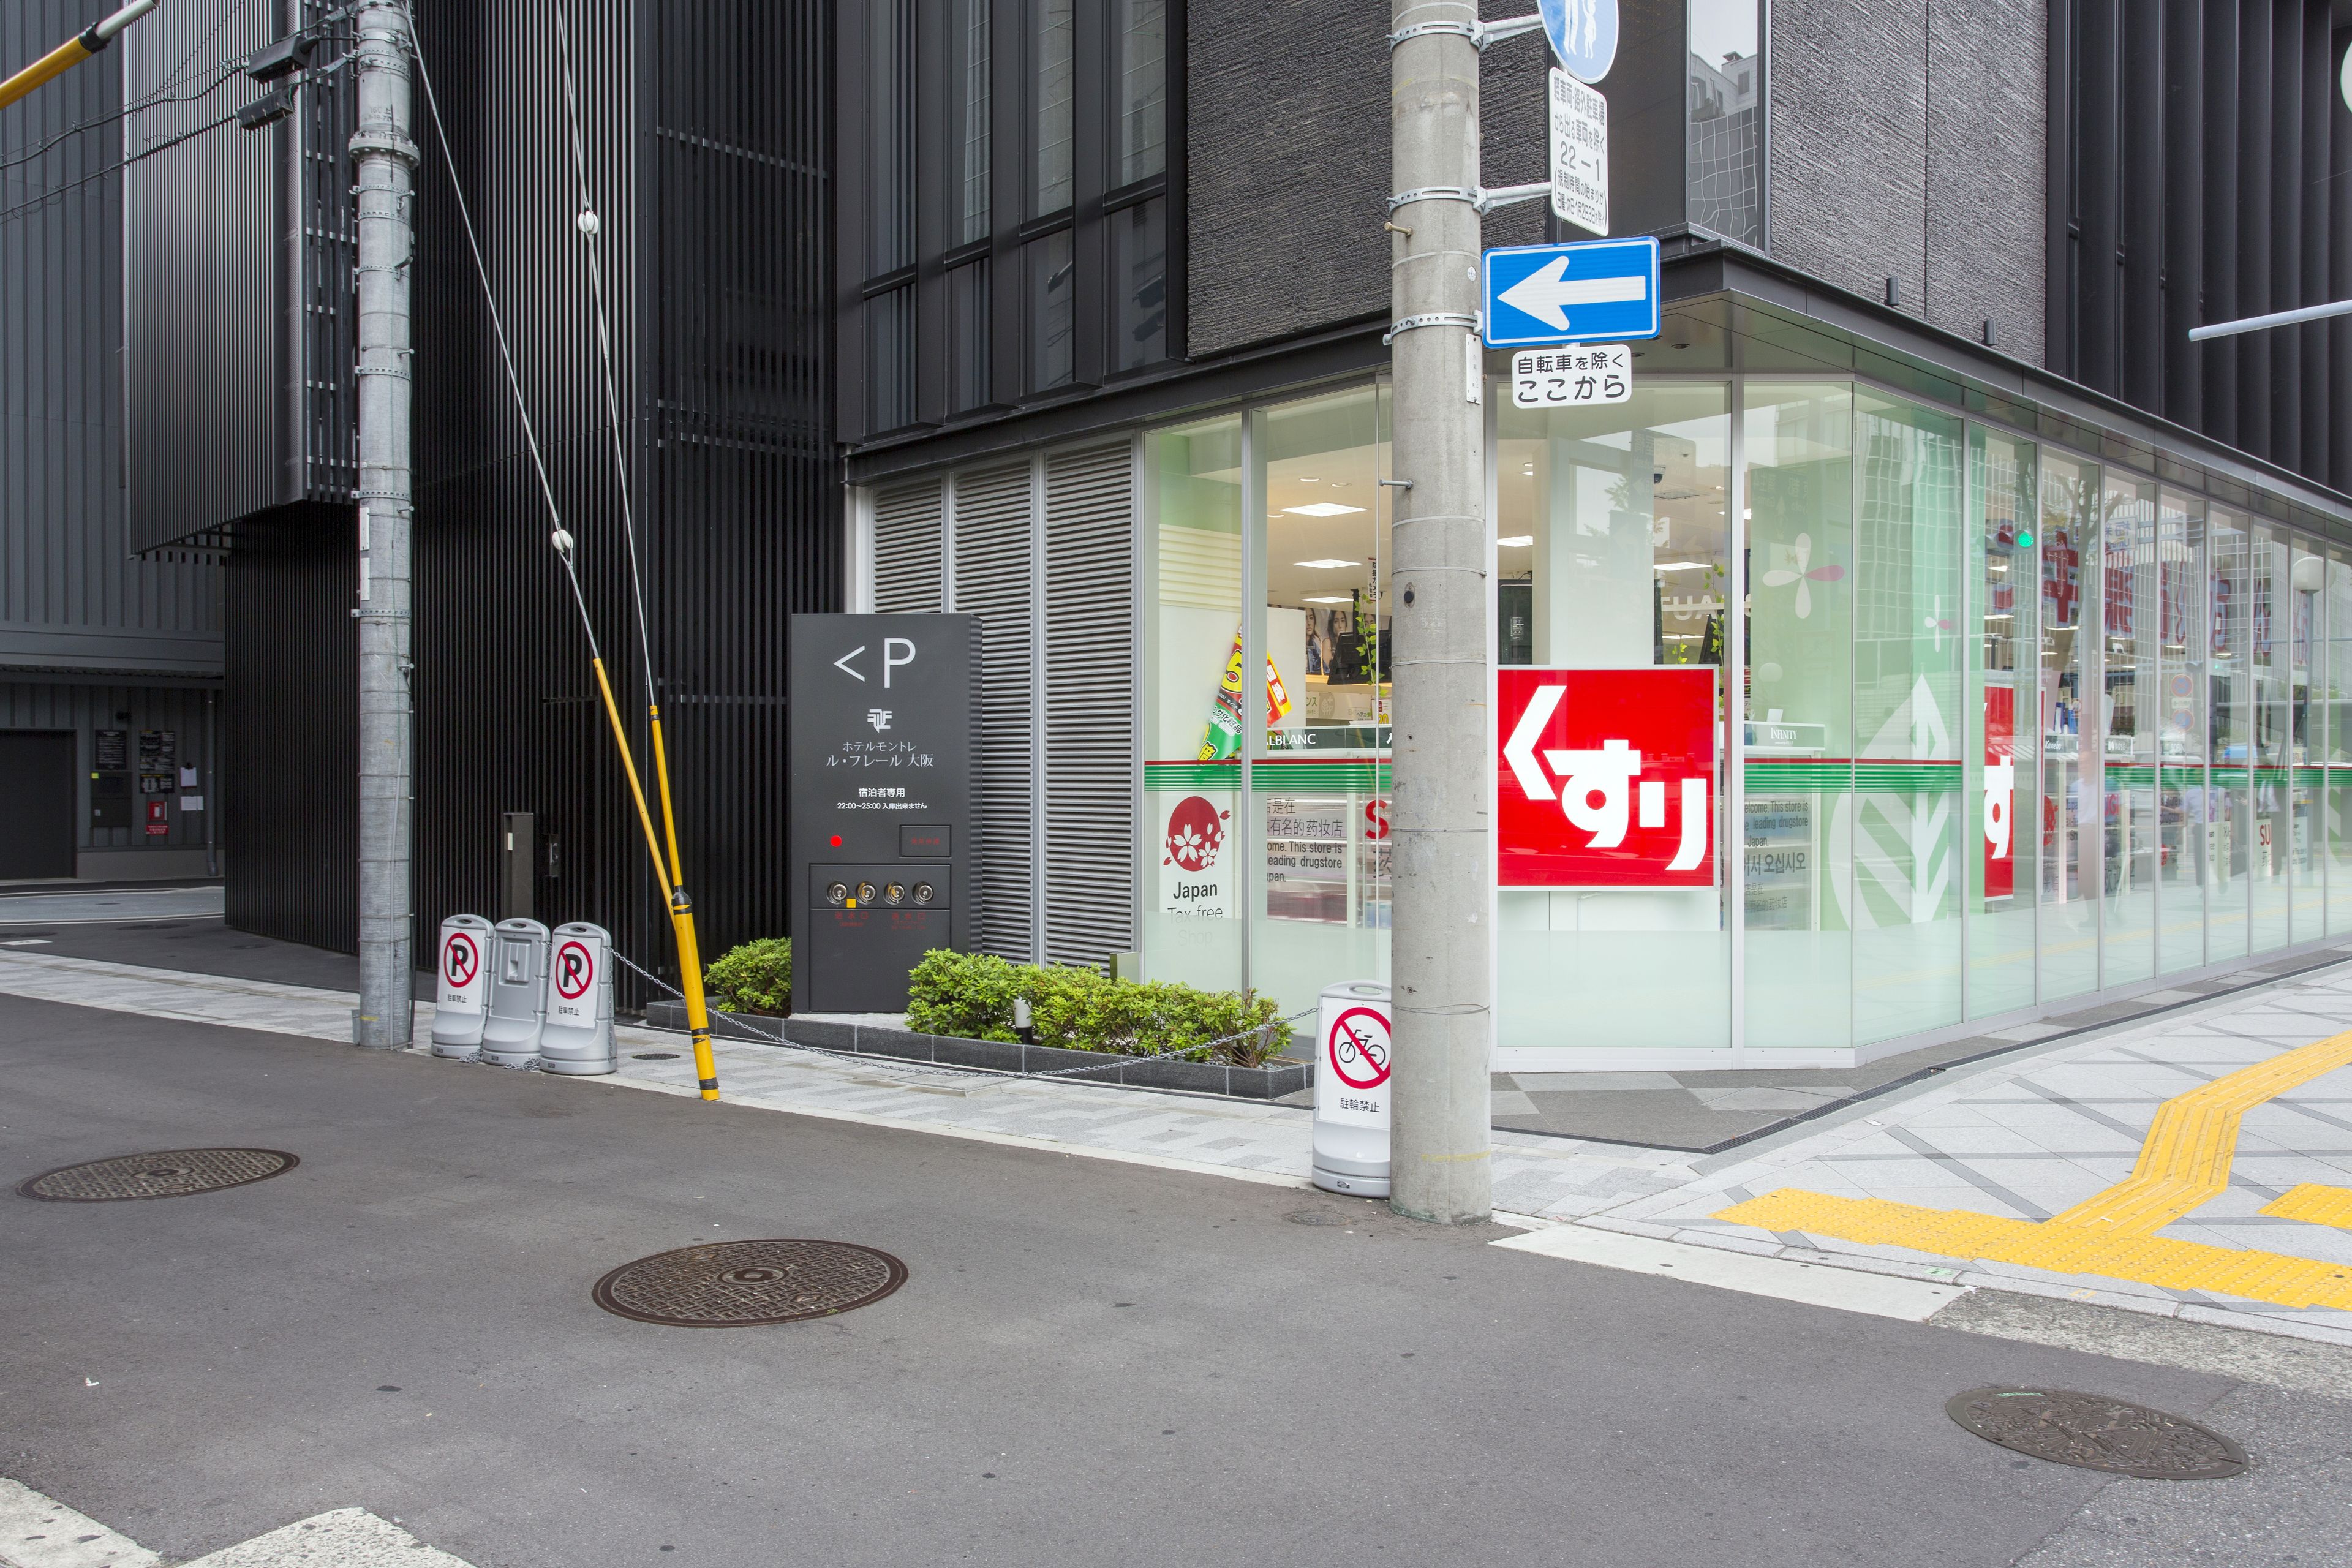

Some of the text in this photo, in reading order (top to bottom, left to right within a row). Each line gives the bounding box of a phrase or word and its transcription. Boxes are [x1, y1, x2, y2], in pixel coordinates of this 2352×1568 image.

[1555, 113, 1605, 156] から出る車両を除く
[1518, 352, 1623, 374] 自転車を除く
[1518, 374, 1626, 403] ここから
[884, 638, 916, 689] P
[843, 741, 917, 752] ホテルモントレ
[826, 753, 934, 767] ル・フレール 大阪
[1503, 685, 1707, 870] くすり
[858, 788, 905, 797] 宿泊者専用
[1771, 801, 1784, 813] This
[1785, 801, 1801, 812] store
[1803, 800, 1809, 812] is
[1267, 818, 1343, 838] 有名的药妆店
[1753, 816, 1776, 829] leading
[1779, 816, 1809, 829] drugstore
[1289, 841, 1306, 853] This
[1309, 842, 1332, 854] store
[1335, 843, 1343, 854] is
[1747, 835, 1769, 848] Japan.
[1300, 856, 1343, 869] drugstore
[1764, 852, 1806, 874] 오십시오
[1173, 881, 1218, 902] Japan
[447, 993, 467, 1004] 駐車禁止
[558, 1006, 579, 1016] 駐車禁止
[1340, 1098, 1381, 1114] 駐輪禁止
